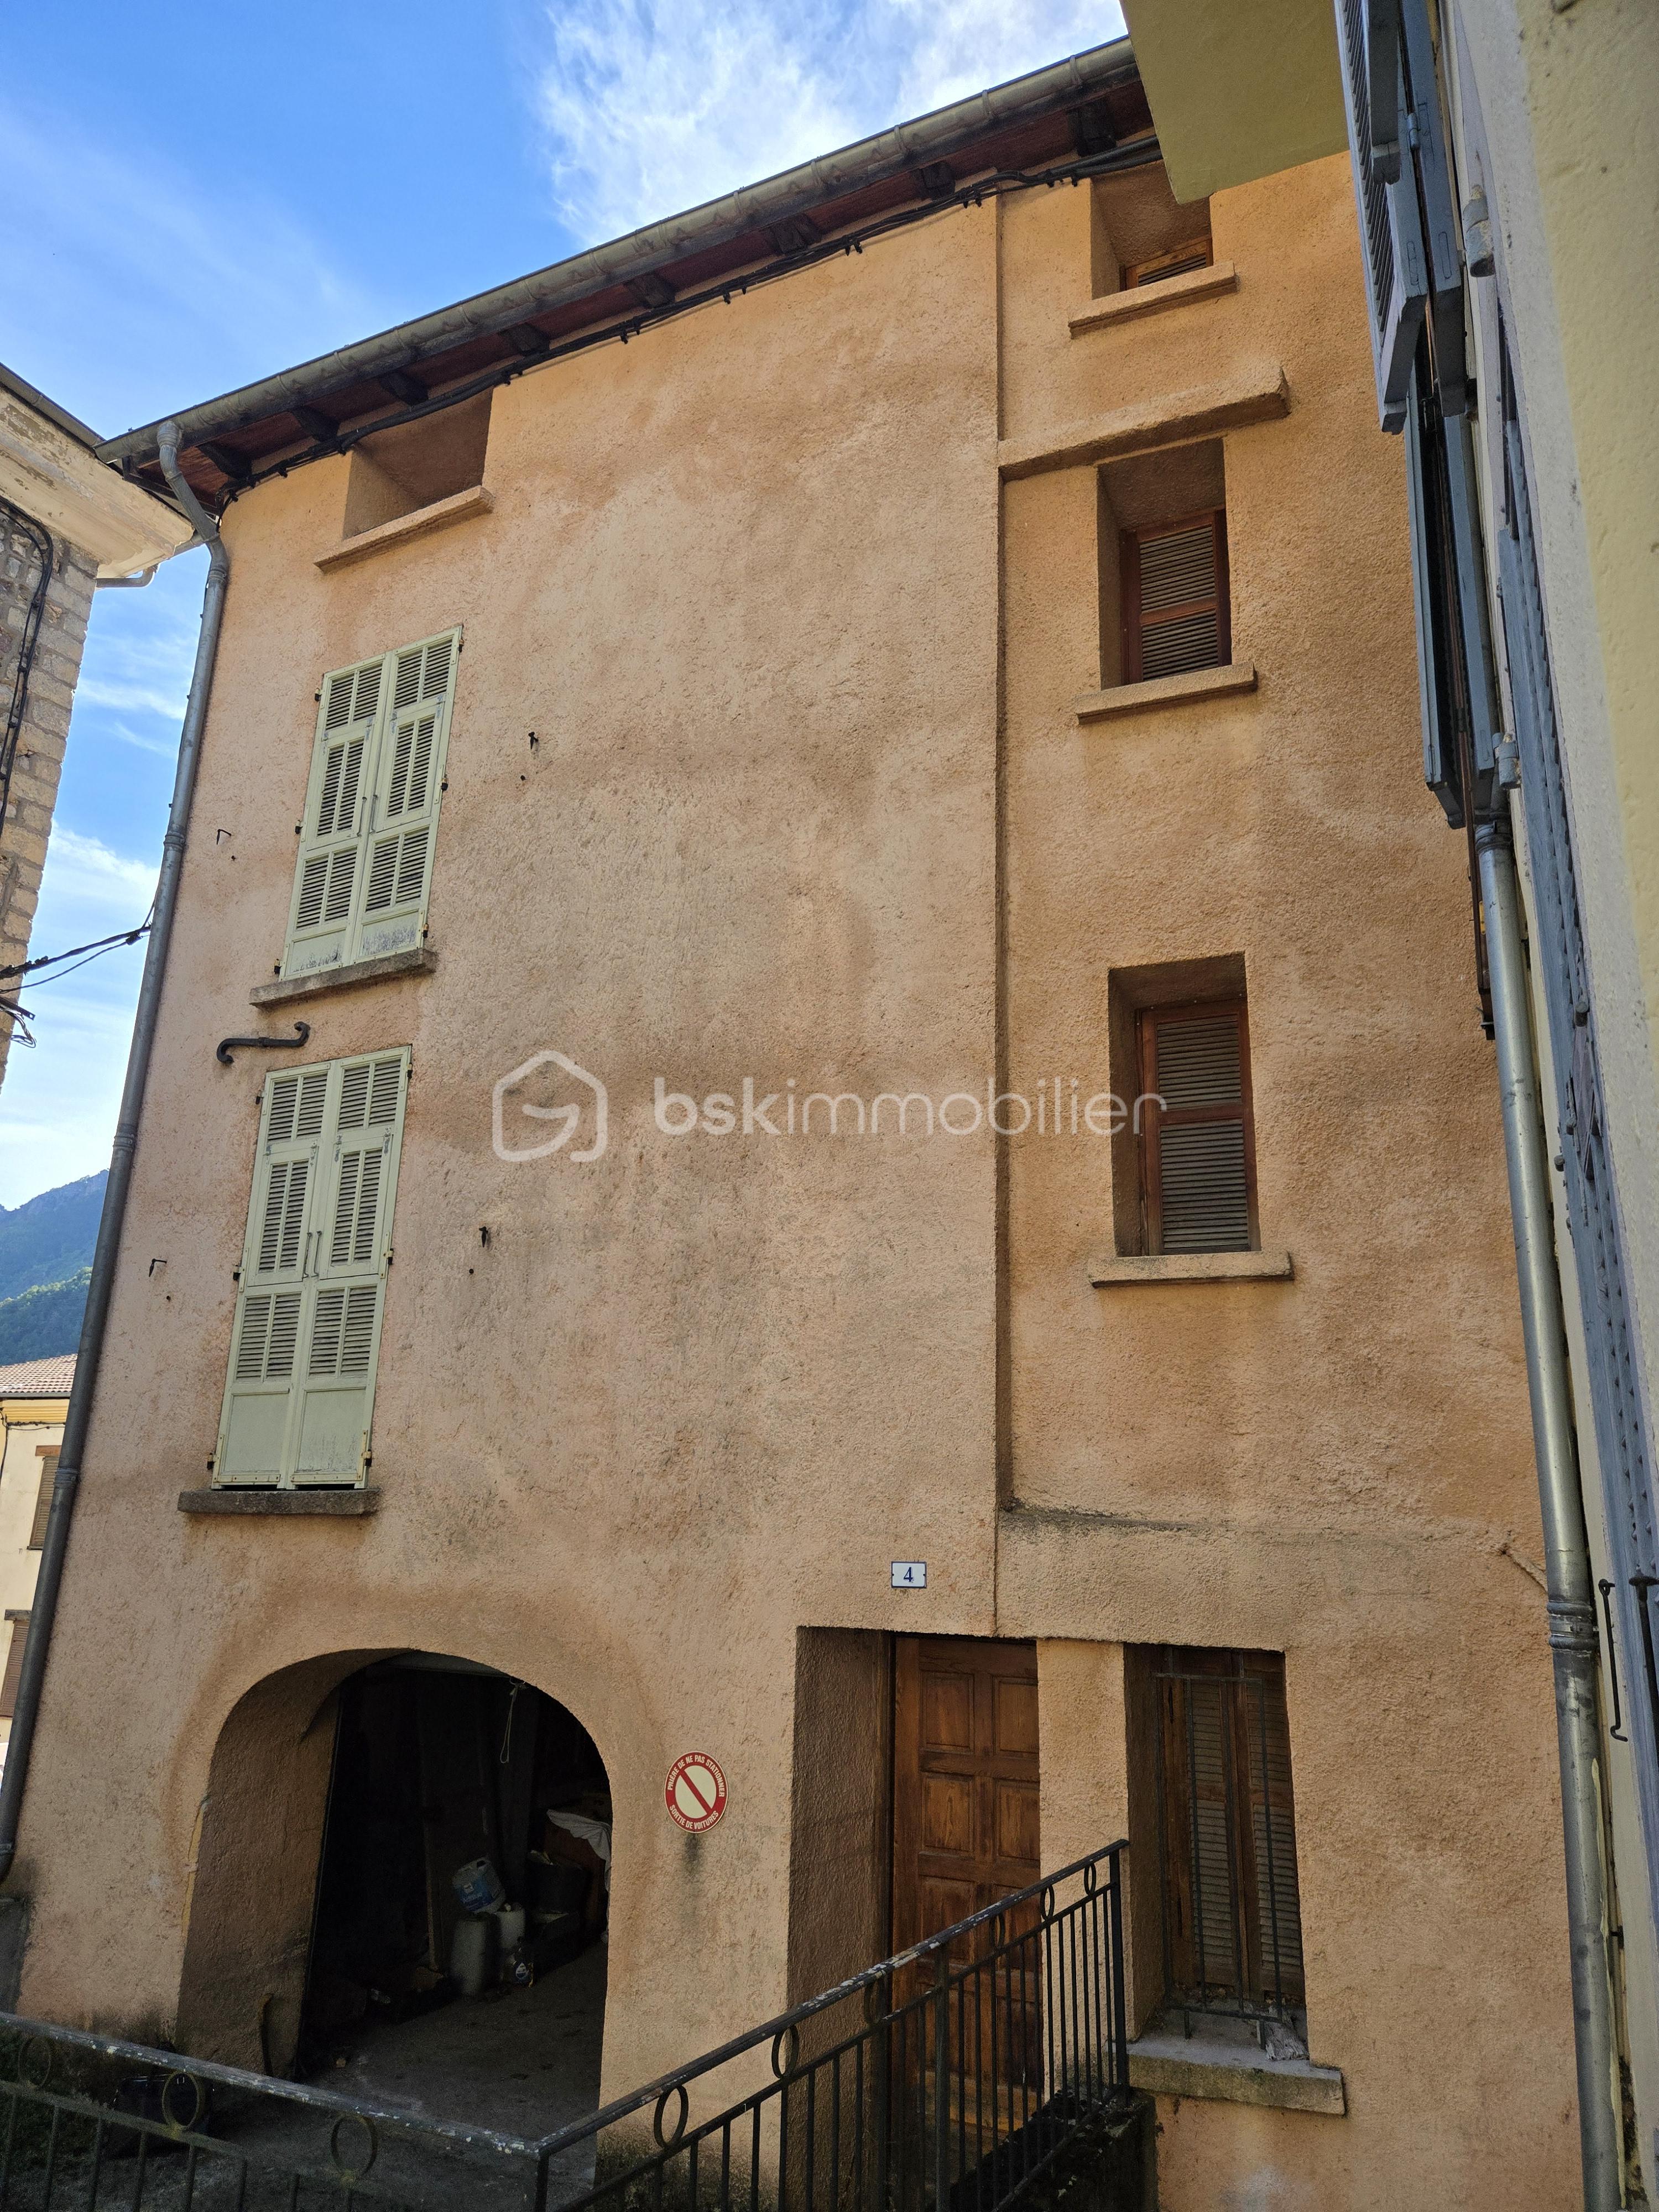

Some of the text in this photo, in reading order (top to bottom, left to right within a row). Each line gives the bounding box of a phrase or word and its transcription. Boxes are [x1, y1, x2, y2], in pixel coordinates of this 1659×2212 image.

[904, 1567, 913, 1582] 4
[667, 1755, 725, 1797] PRIÈRE DE NE PAS STATIONNER
[670, 1804, 719, 1830] SORTIE DE VOITURES
